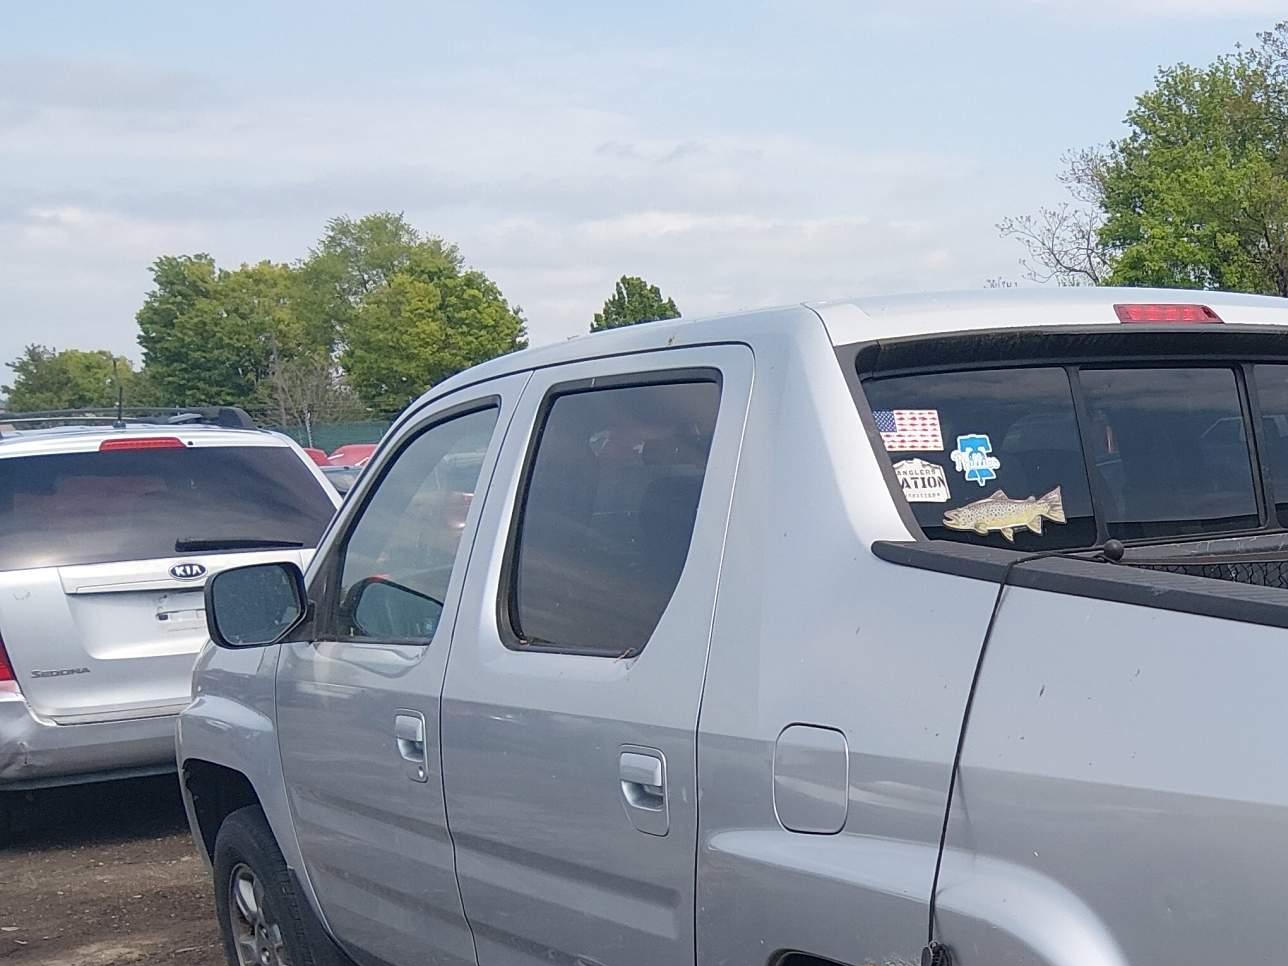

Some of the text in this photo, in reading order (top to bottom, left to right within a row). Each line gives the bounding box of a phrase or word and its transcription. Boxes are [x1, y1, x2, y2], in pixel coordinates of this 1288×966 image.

[896, 468, 936, 476] ANGLERS
[902, 476, 946, 489] ATION
[174, 565, 202, 576] KIA
